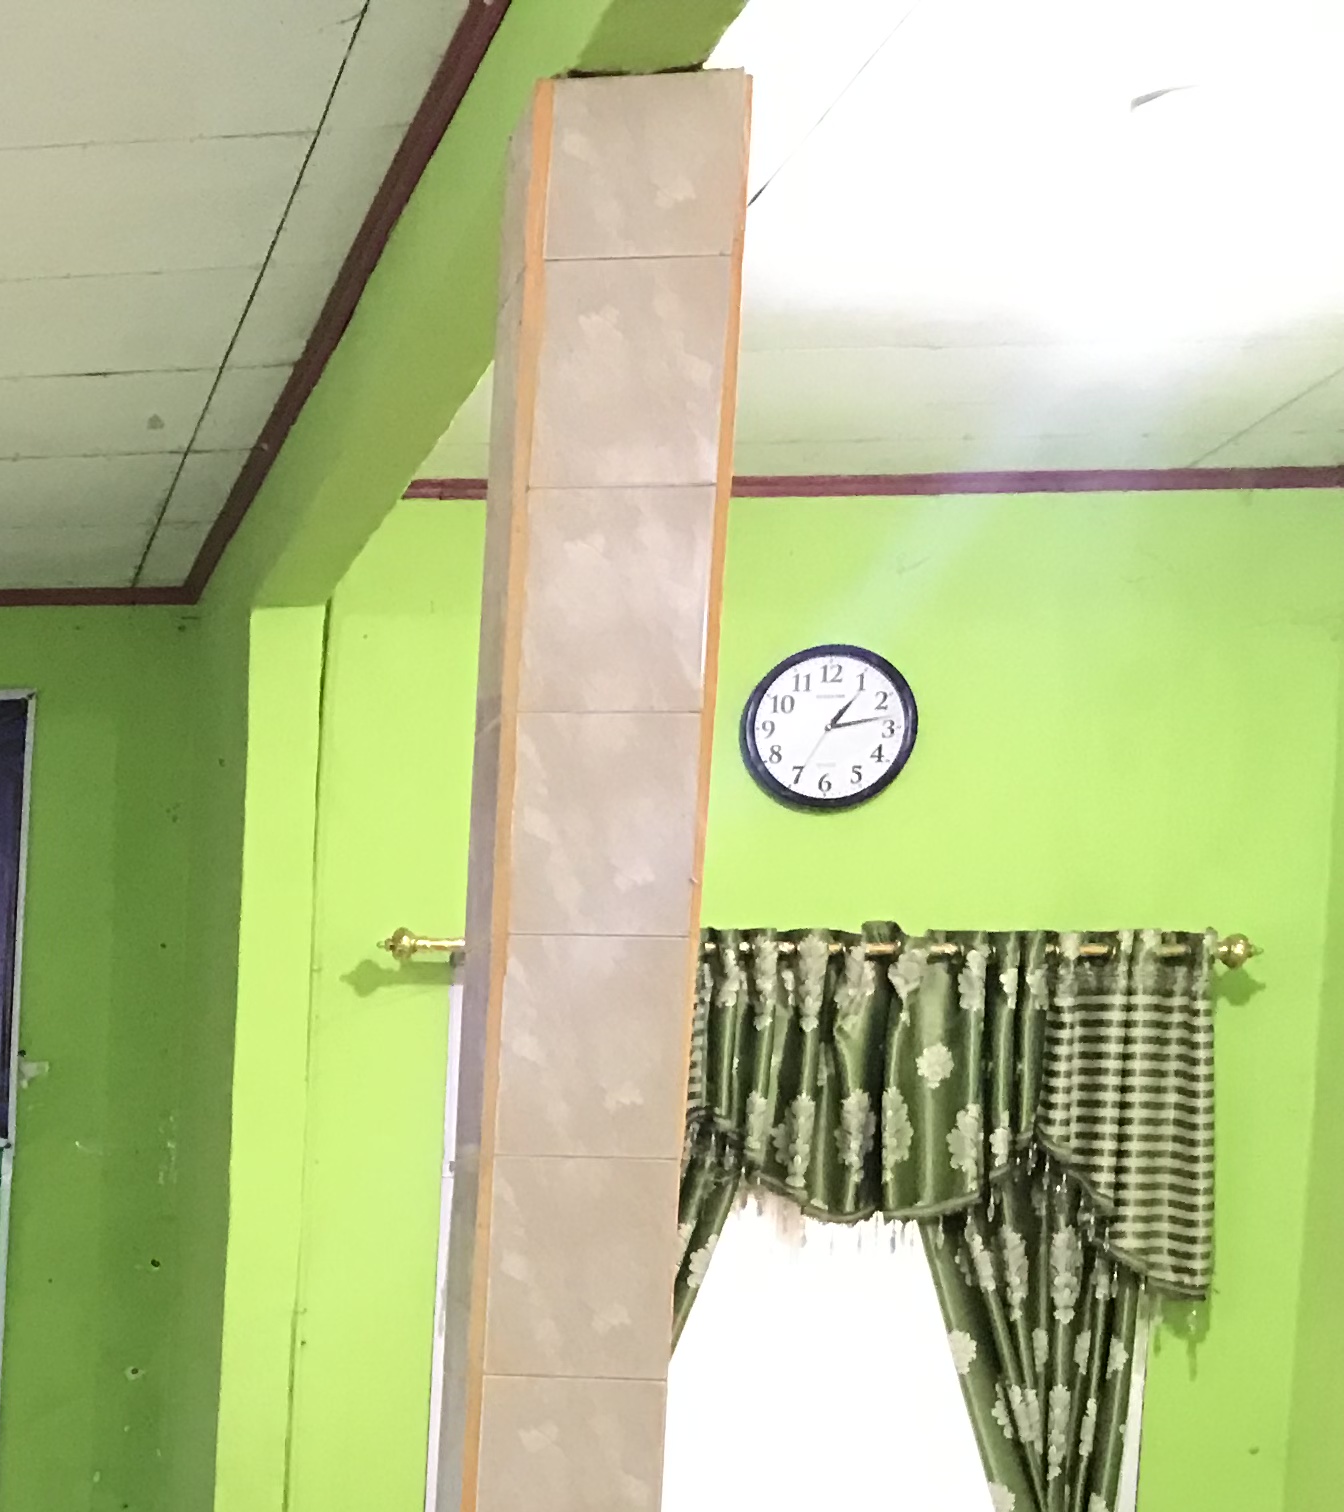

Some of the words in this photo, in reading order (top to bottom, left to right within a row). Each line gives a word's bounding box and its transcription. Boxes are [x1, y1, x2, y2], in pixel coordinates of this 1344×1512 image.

[792, 673, 811, 692] 11
[820, 664, 843, 683] 12
[856, 673, 866, 692] 1
[771, 695, 795, 714] 10
[874, 691, 889, 710] 2
[761, 720, 776, 739] 9
[881, 719, 895, 739] 3
[768, 745, 783, 764] 8
[870, 744, 884, 763] 4
[792, 766, 805, 785] 7
[818, 773, 832, 792] 6
[850, 765, 863, 784] 5
